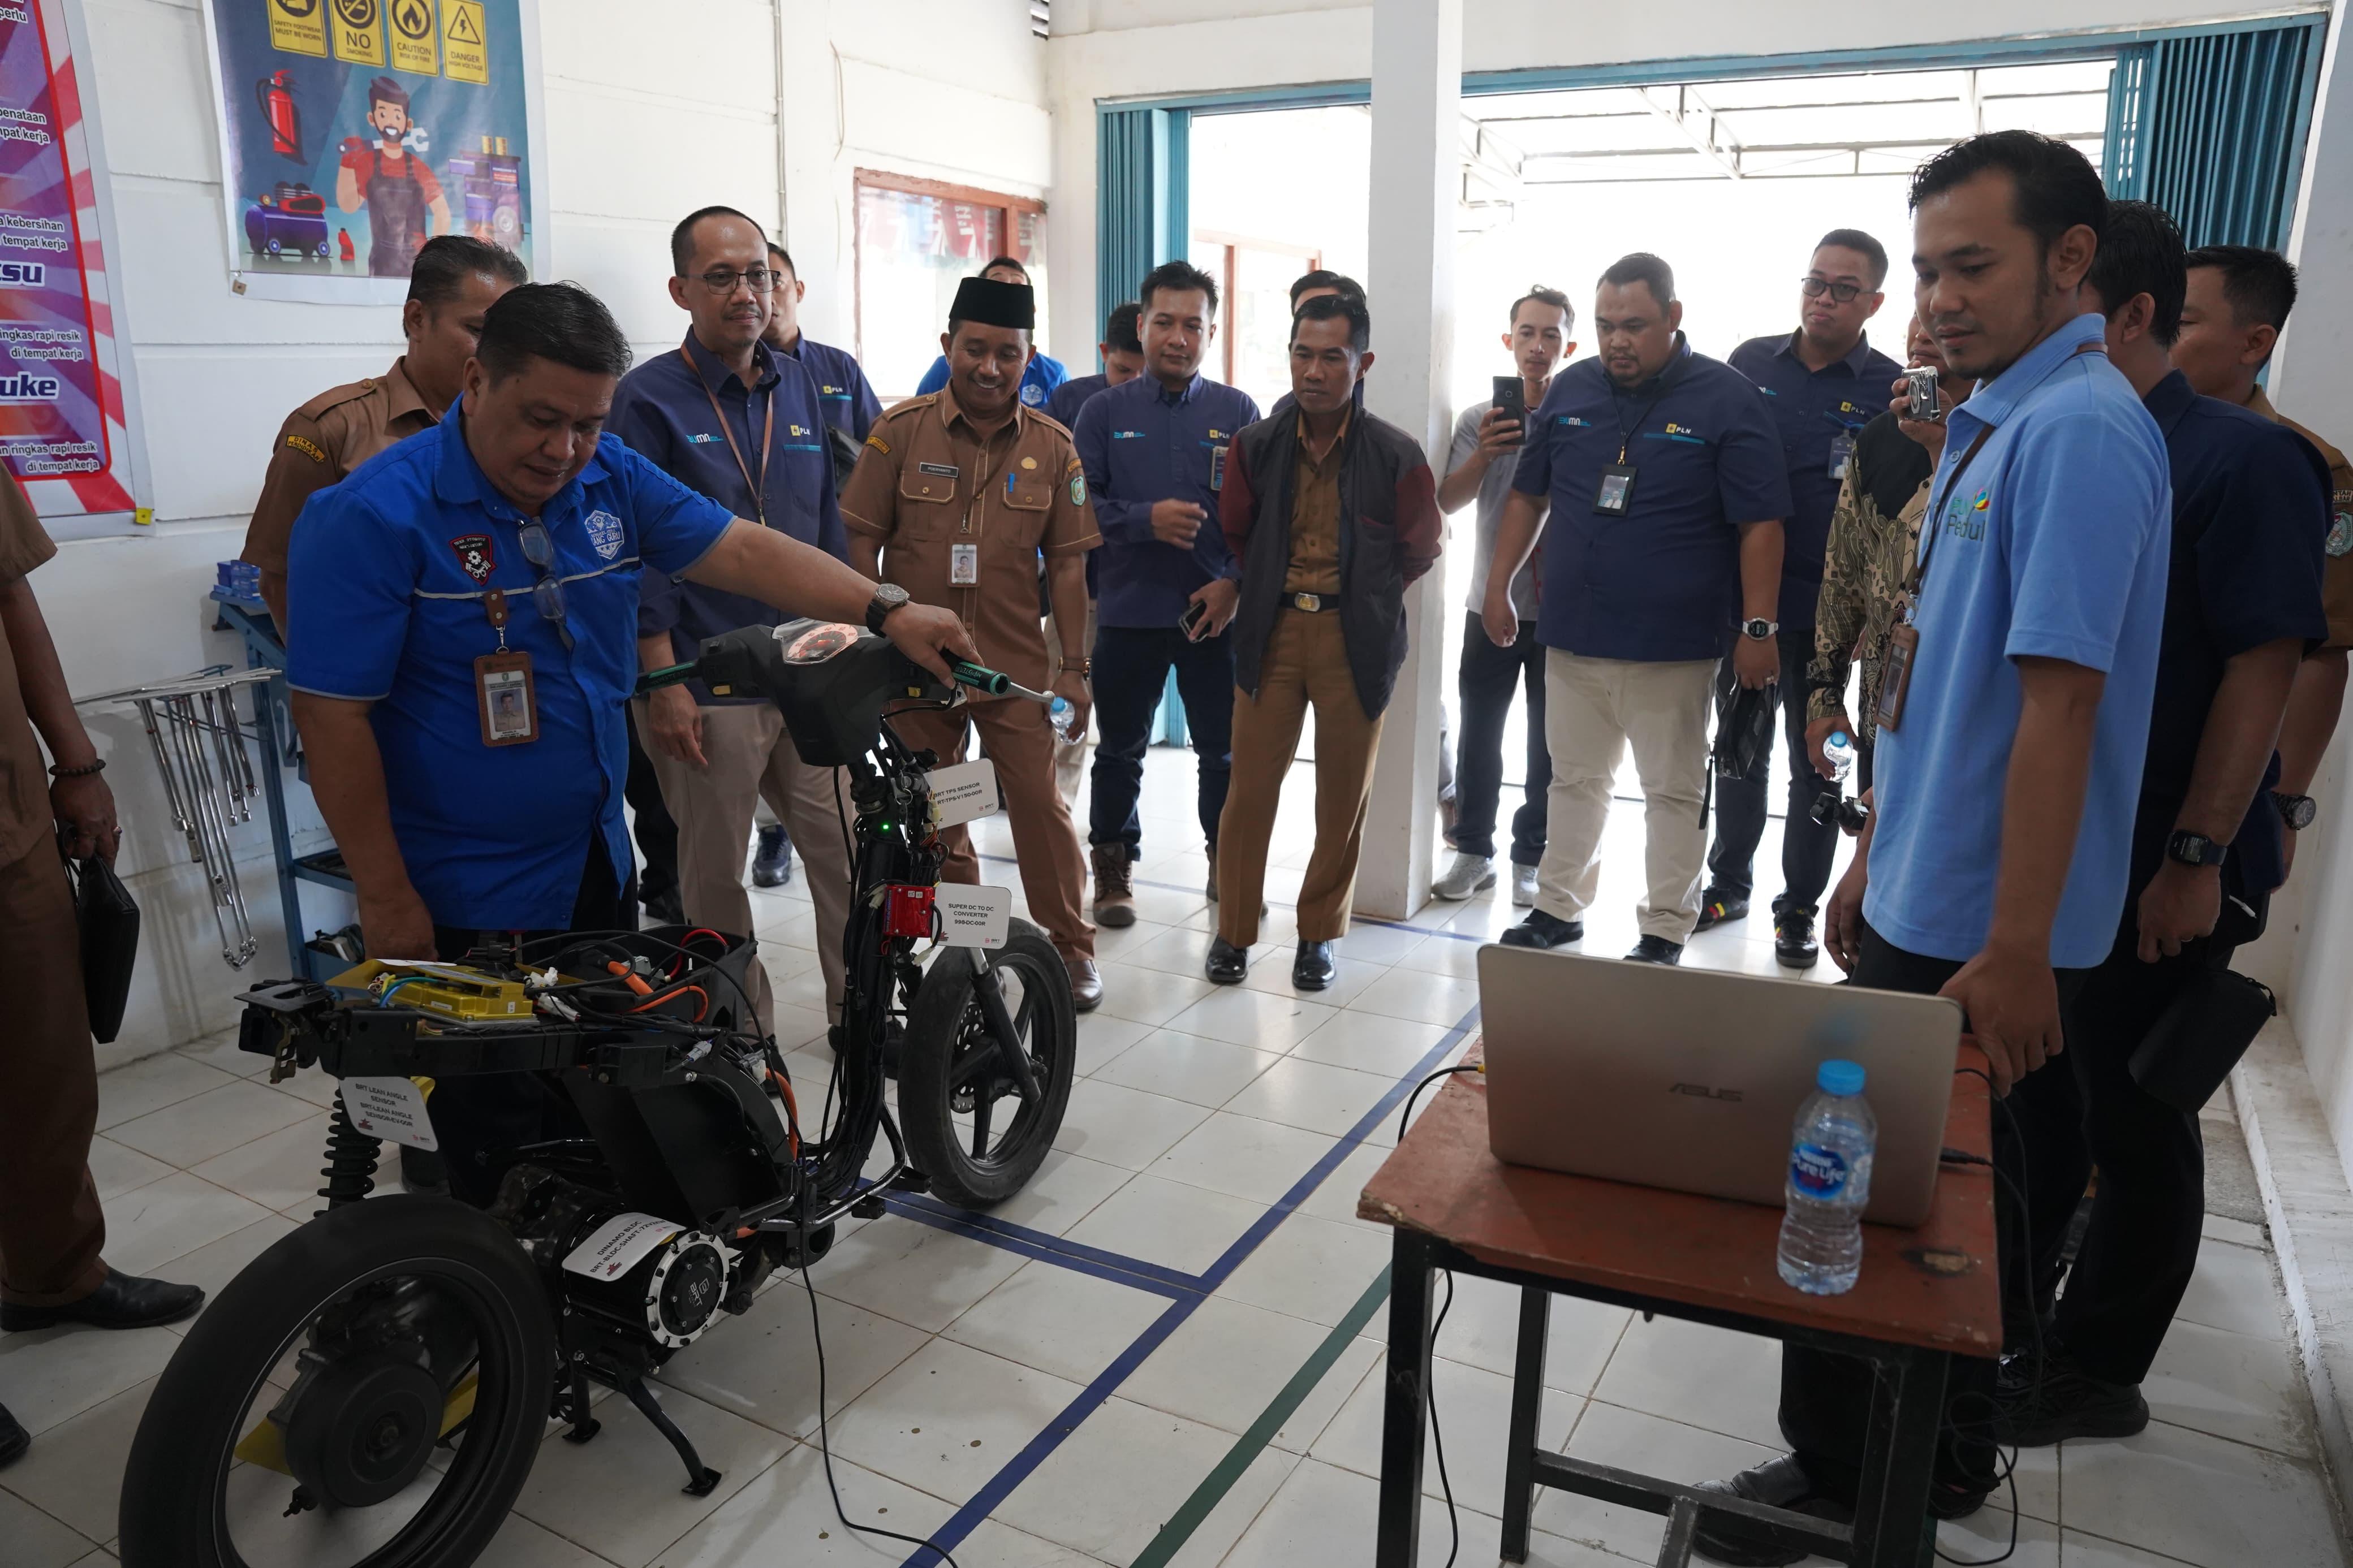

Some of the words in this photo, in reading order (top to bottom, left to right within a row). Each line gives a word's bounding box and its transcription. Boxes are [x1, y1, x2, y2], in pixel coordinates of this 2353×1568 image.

[293, 23, 321, 33] FOOTWEAR
[303, 33, 322, 41] WORN
[346, 31, 371, 49] NO
[346, 47, 372, 58] SMOKING
[397, 42, 432, 55] CAUTION
[450, 51, 480, 63] DANGER
[462, 62, 484, 71] VOLTAGE
[23, 128, 49, 144] kerja
[6, 216, 63, 231] kebersihan
[3, 235, 39, 248] tempat
[41, 237, 67, 251] kerja
[0, 264, 42, 283] su
[36, 331, 54, 343] rapi
[57, 330, 80, 340] resik
[11, 348, 21, 357] di
[24, 348, 57, 360] tempat
[59, 349, 83, 360] kerja
[0, 374, 57, 396] uke
[1851, 406, 1865, 416] PLN
[799, 427, 811, 435] PLN
[11, 443, 49, 456] ringkas
[51, 443, 71, 455] rapi
[73, 443, 96, 452] resik
[287, 441, 320, 460] PENDIDIKAN
[294, 437, 318, 453] DINAS
[39, 461, 73, 472] tempat
[75, 460, 98, 470] kerja
[607, 531, 620, 542] GURU
[957, 782, 980, 792] SENSOR
[937, 789, 982, 805] RT-TPS-V150-00R
[369, 1087, 386, 1096] LEAN
[386, 1092, 408, 1102] ANGLE
[1667, 1083, 1743, 1102] ASUS
[370, 1095, 397, 1106] SENSOR
[391, 1110, 413, 1120] ANGLE
[597, 1232, 625, 1255] DINAMO
[623, 1221, 642, 1233] BLDC
[689, 1281, 703, 1307] BRT
